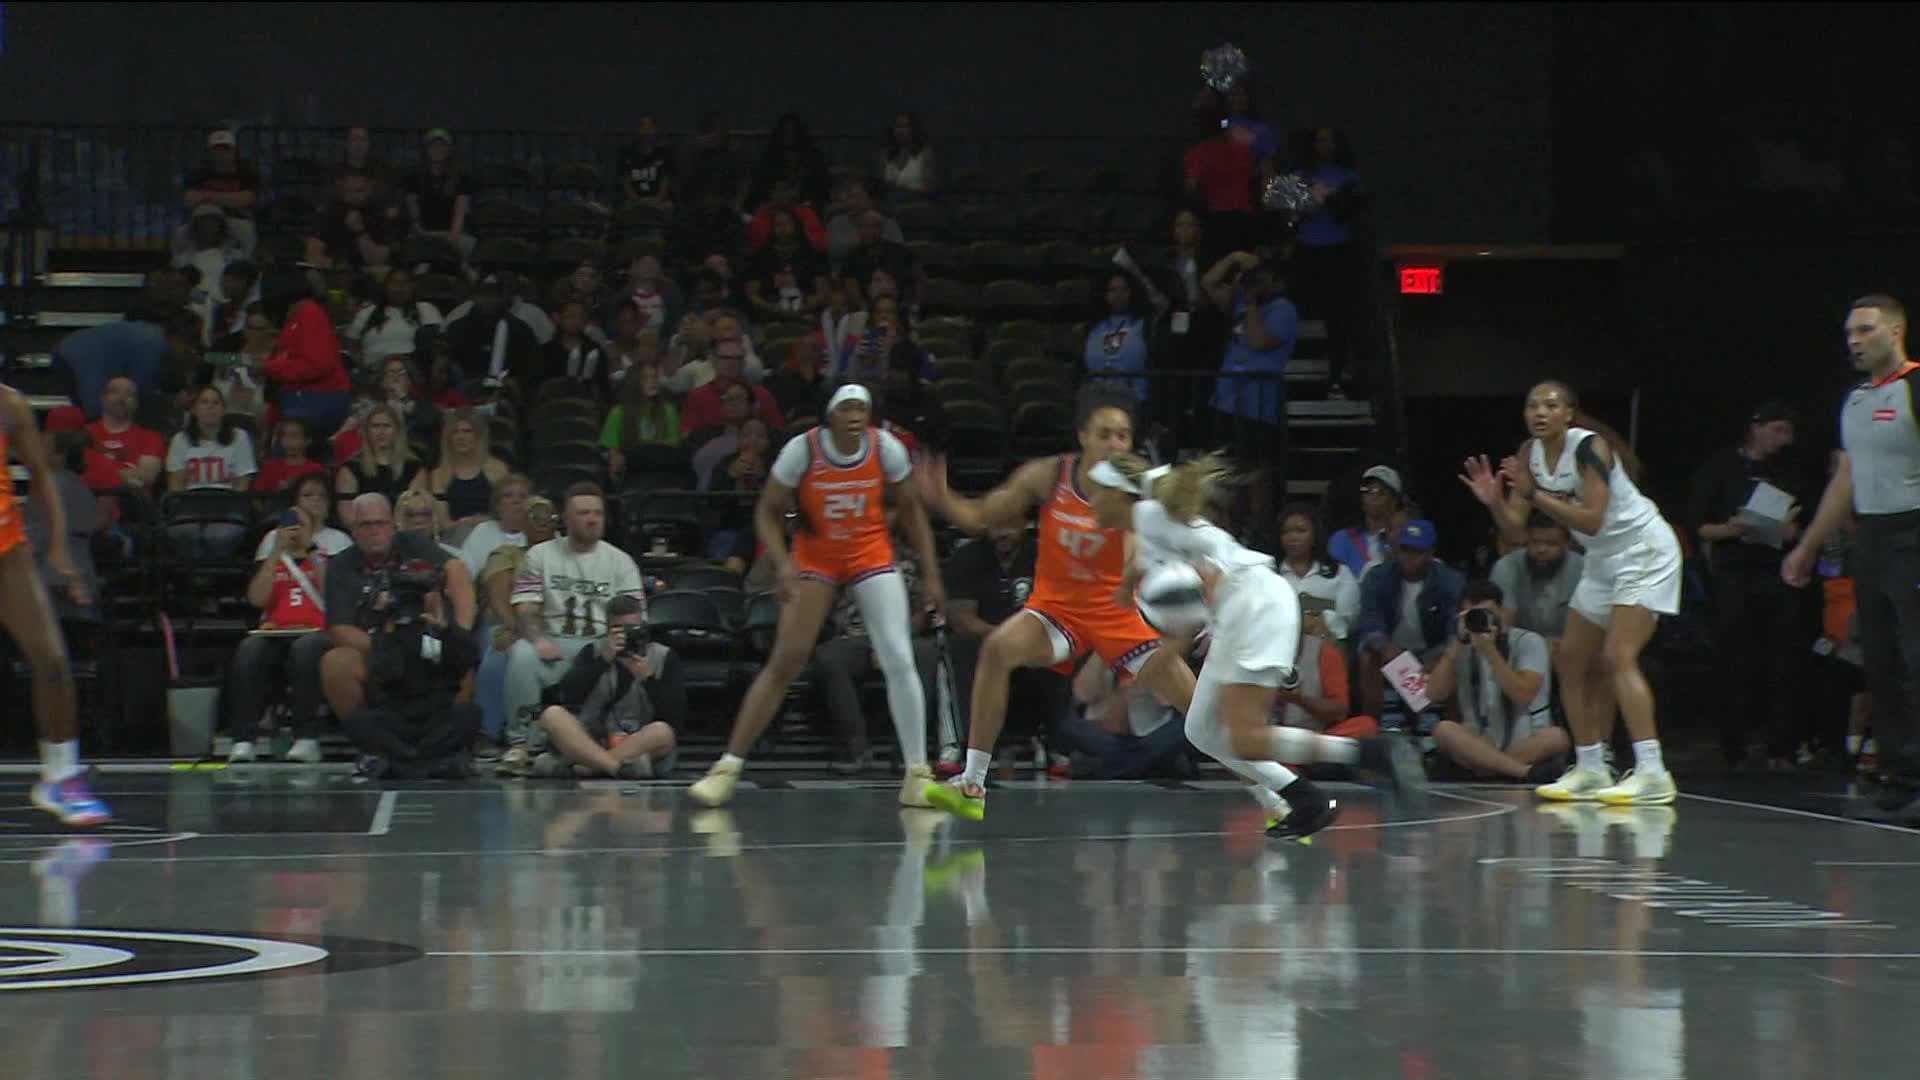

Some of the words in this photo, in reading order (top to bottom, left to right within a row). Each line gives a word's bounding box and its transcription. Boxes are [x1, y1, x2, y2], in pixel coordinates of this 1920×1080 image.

[1401, 268, 1440, 293] EXIT
[824, 493, 867, 518] 24
[1058, 528, 1106, 558] 47
[289, 588, 304, 607] 5
[562, 597, 597, 635] 11
